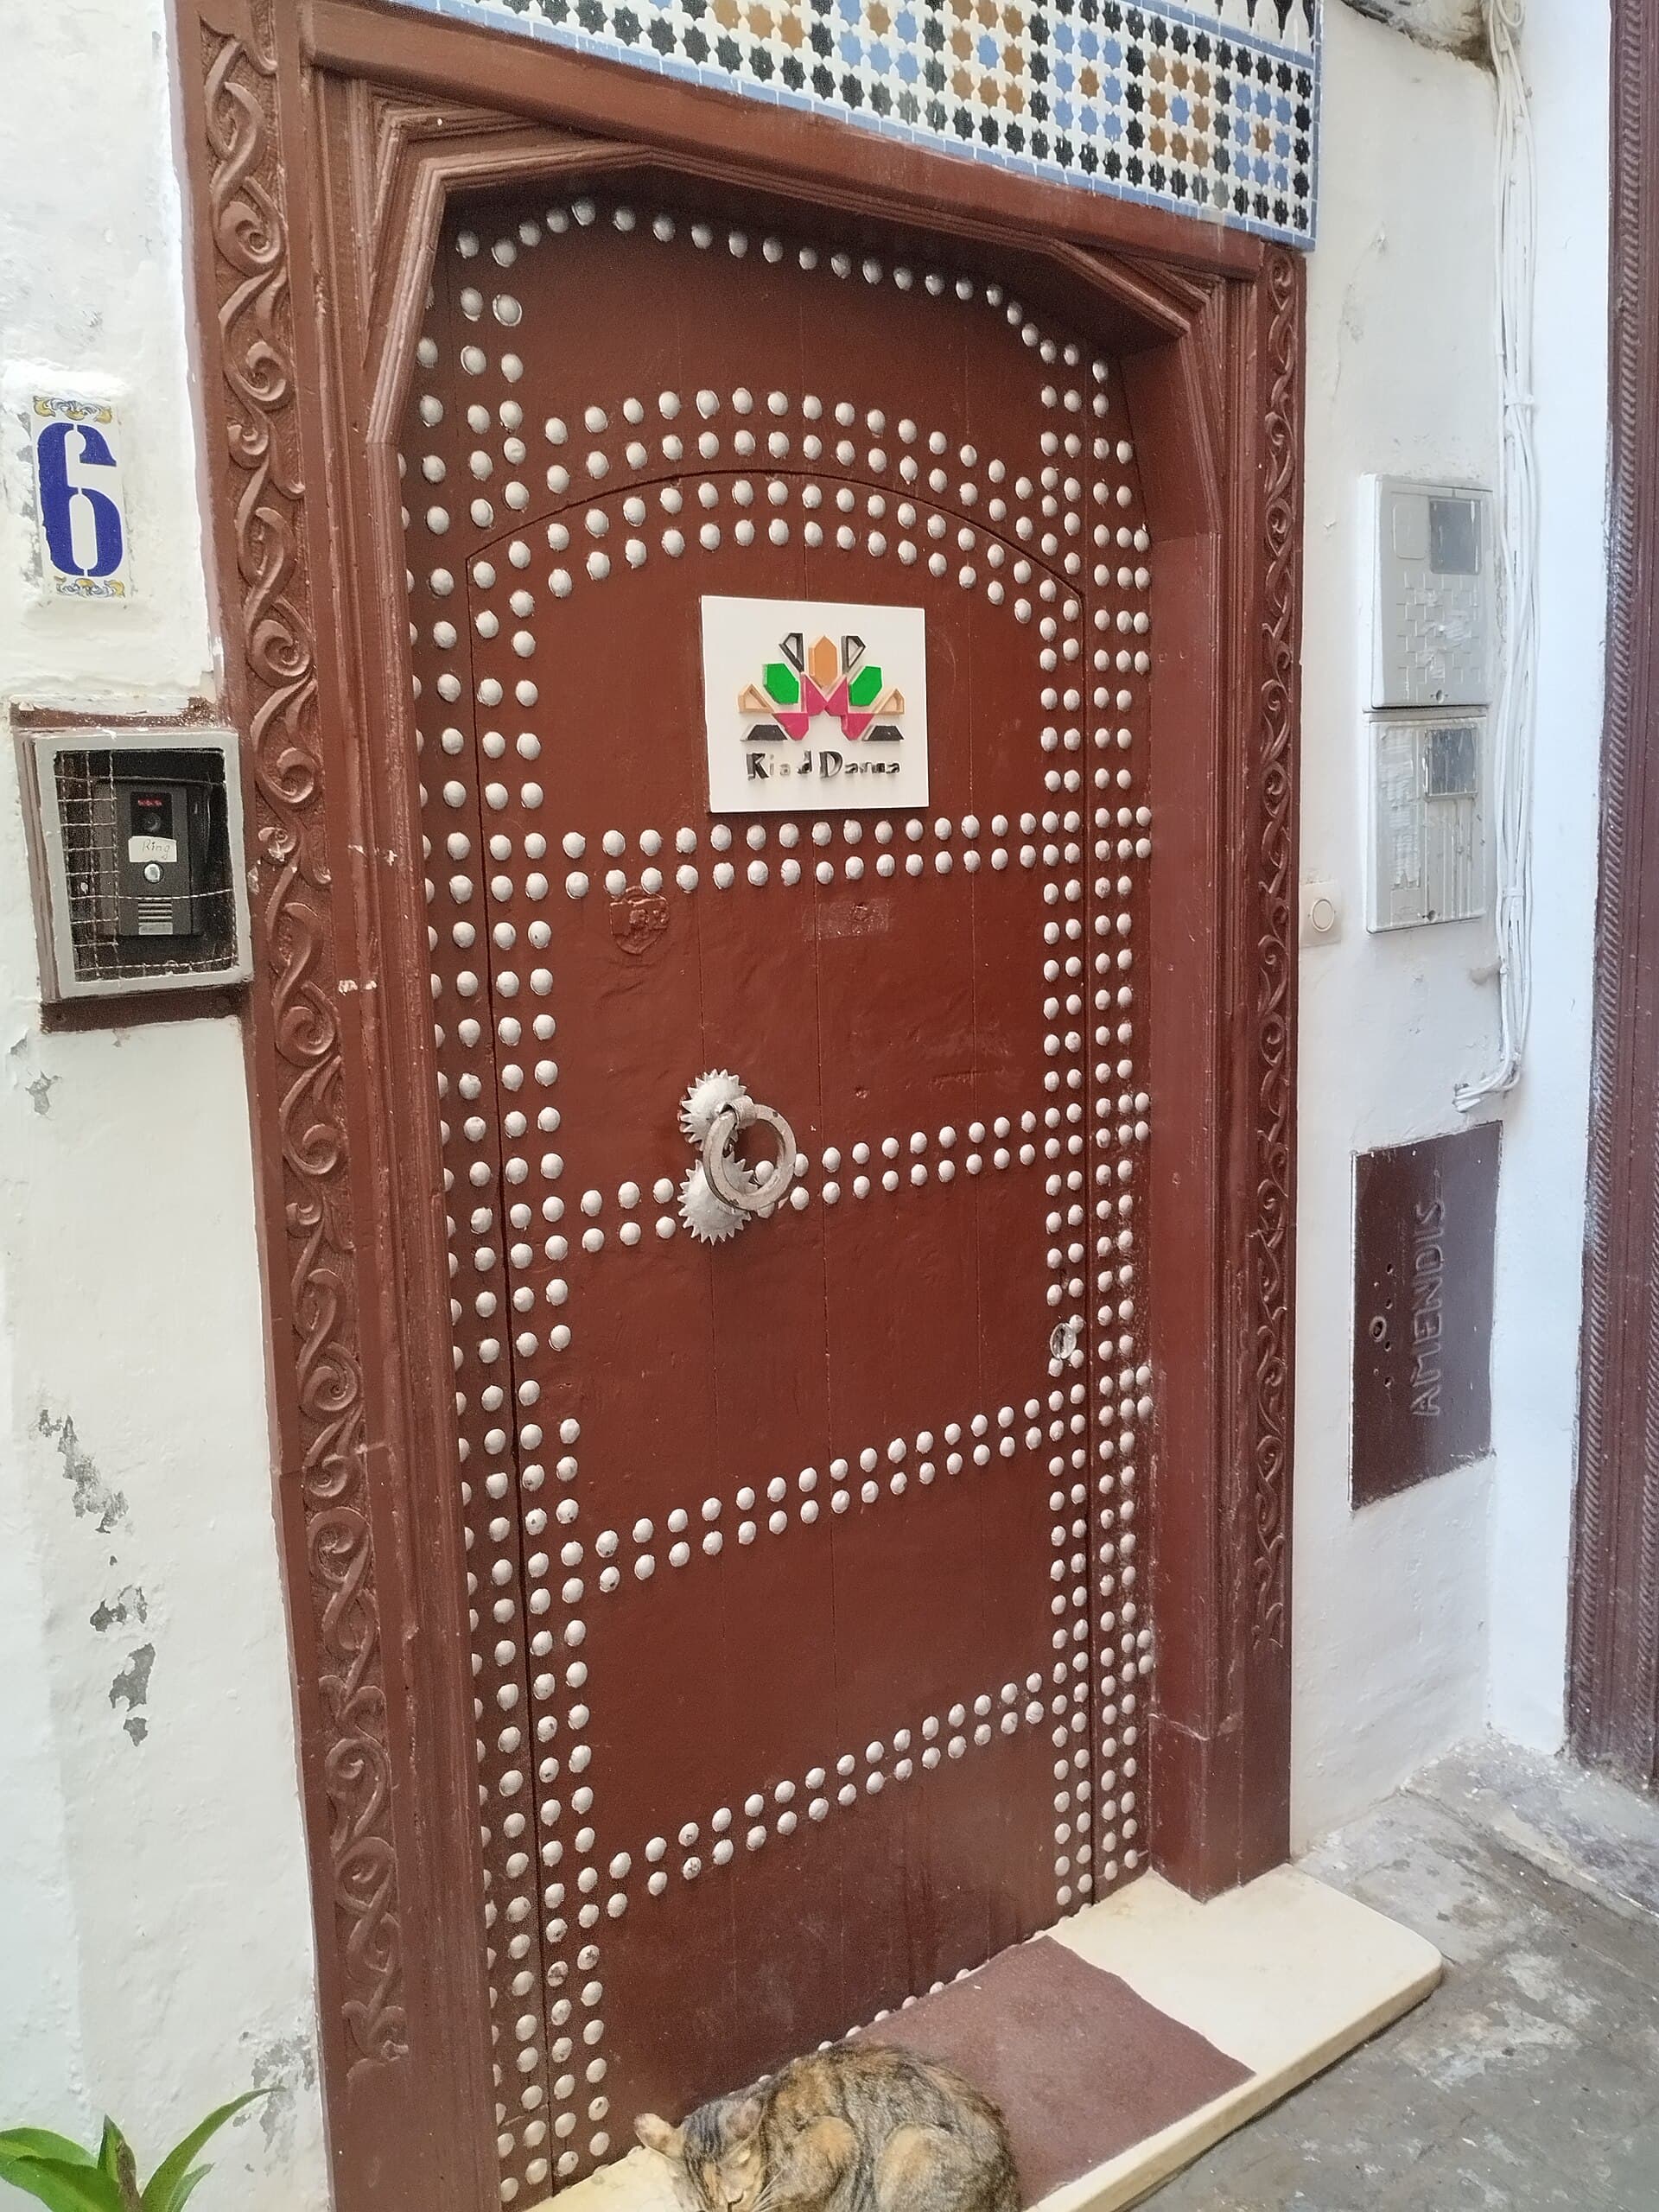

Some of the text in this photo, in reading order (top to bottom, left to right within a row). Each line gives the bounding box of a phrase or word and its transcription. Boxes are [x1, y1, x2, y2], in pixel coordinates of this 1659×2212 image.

[37, 422, 123, 577] 6
[142, 838, 171, 860] Ring
[1410, 1198, 1445, 1417] AMENDIS
